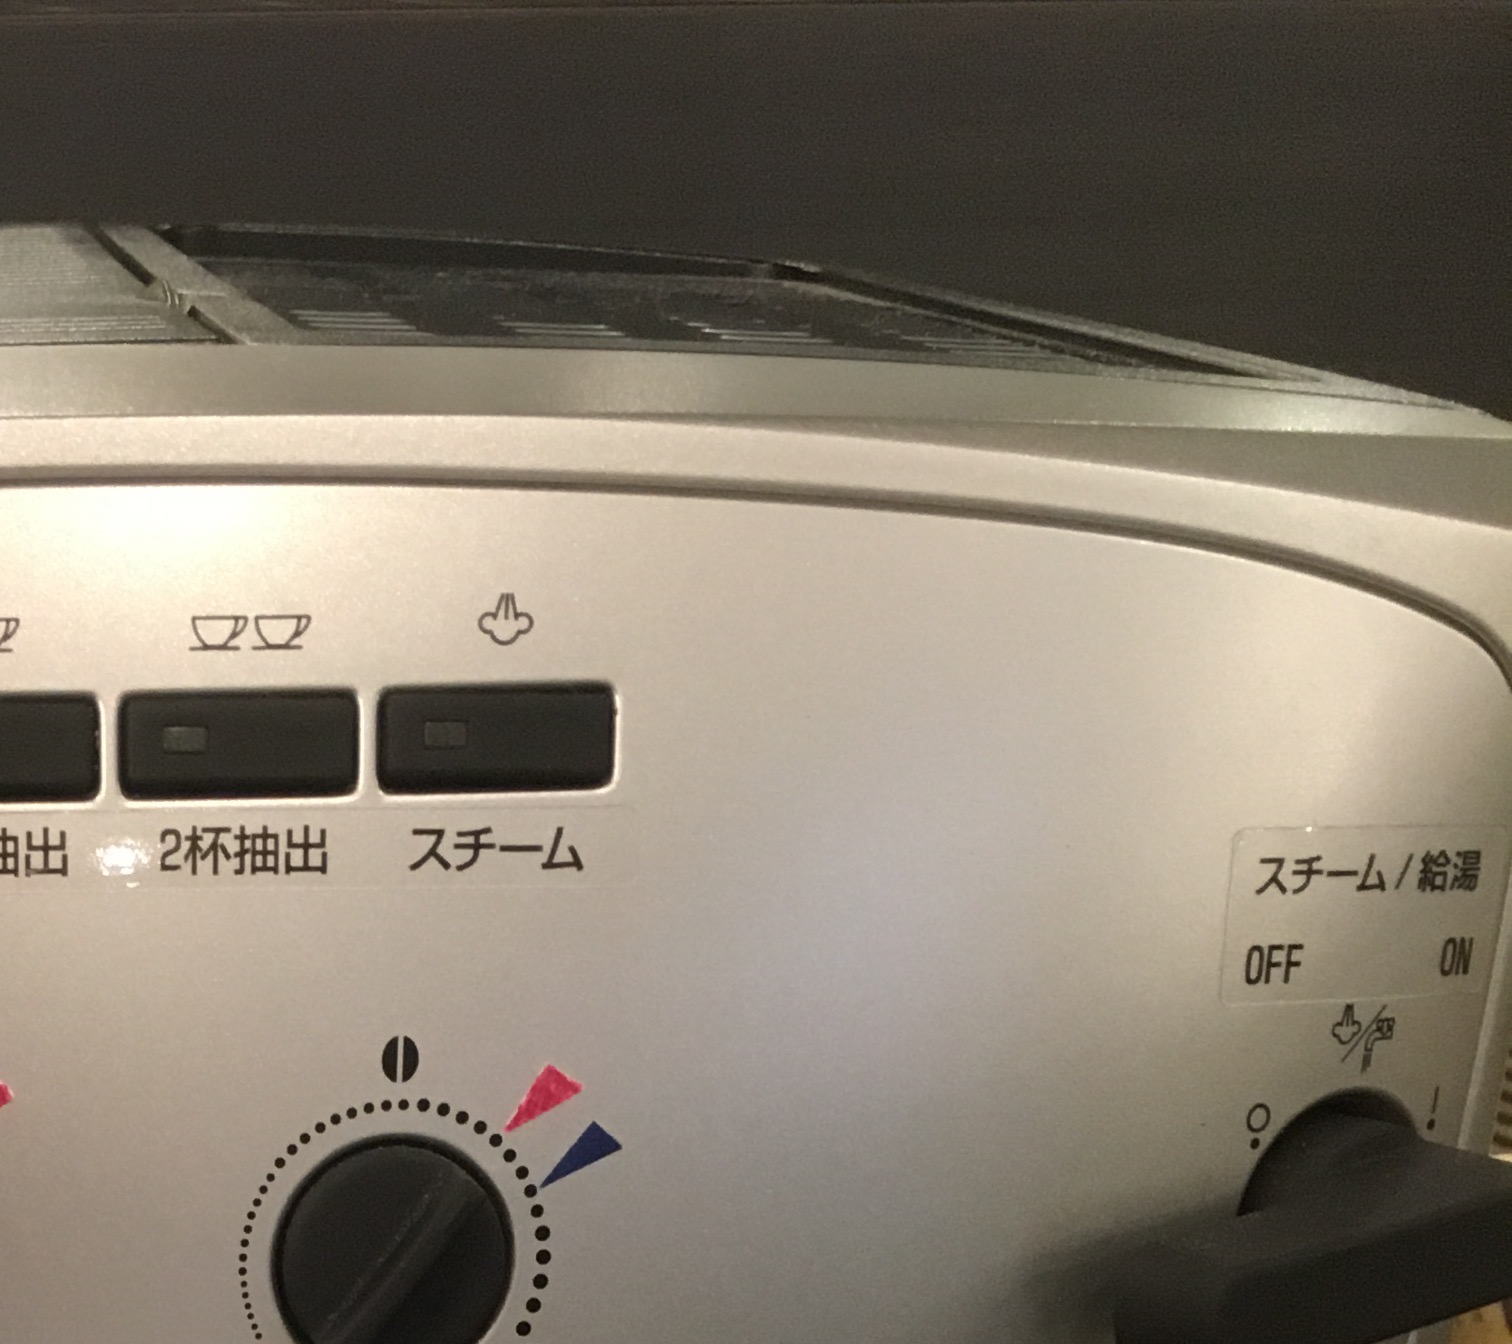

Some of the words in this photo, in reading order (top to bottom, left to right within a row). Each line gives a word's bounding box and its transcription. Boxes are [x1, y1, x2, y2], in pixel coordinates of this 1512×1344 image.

[159, 824, 328, 876] 2杯抽出
[408, 826, 584, 872] スチーム
[1244, 943, 1305, 985] OFF
[1439, 936, 1474, 977] ON
